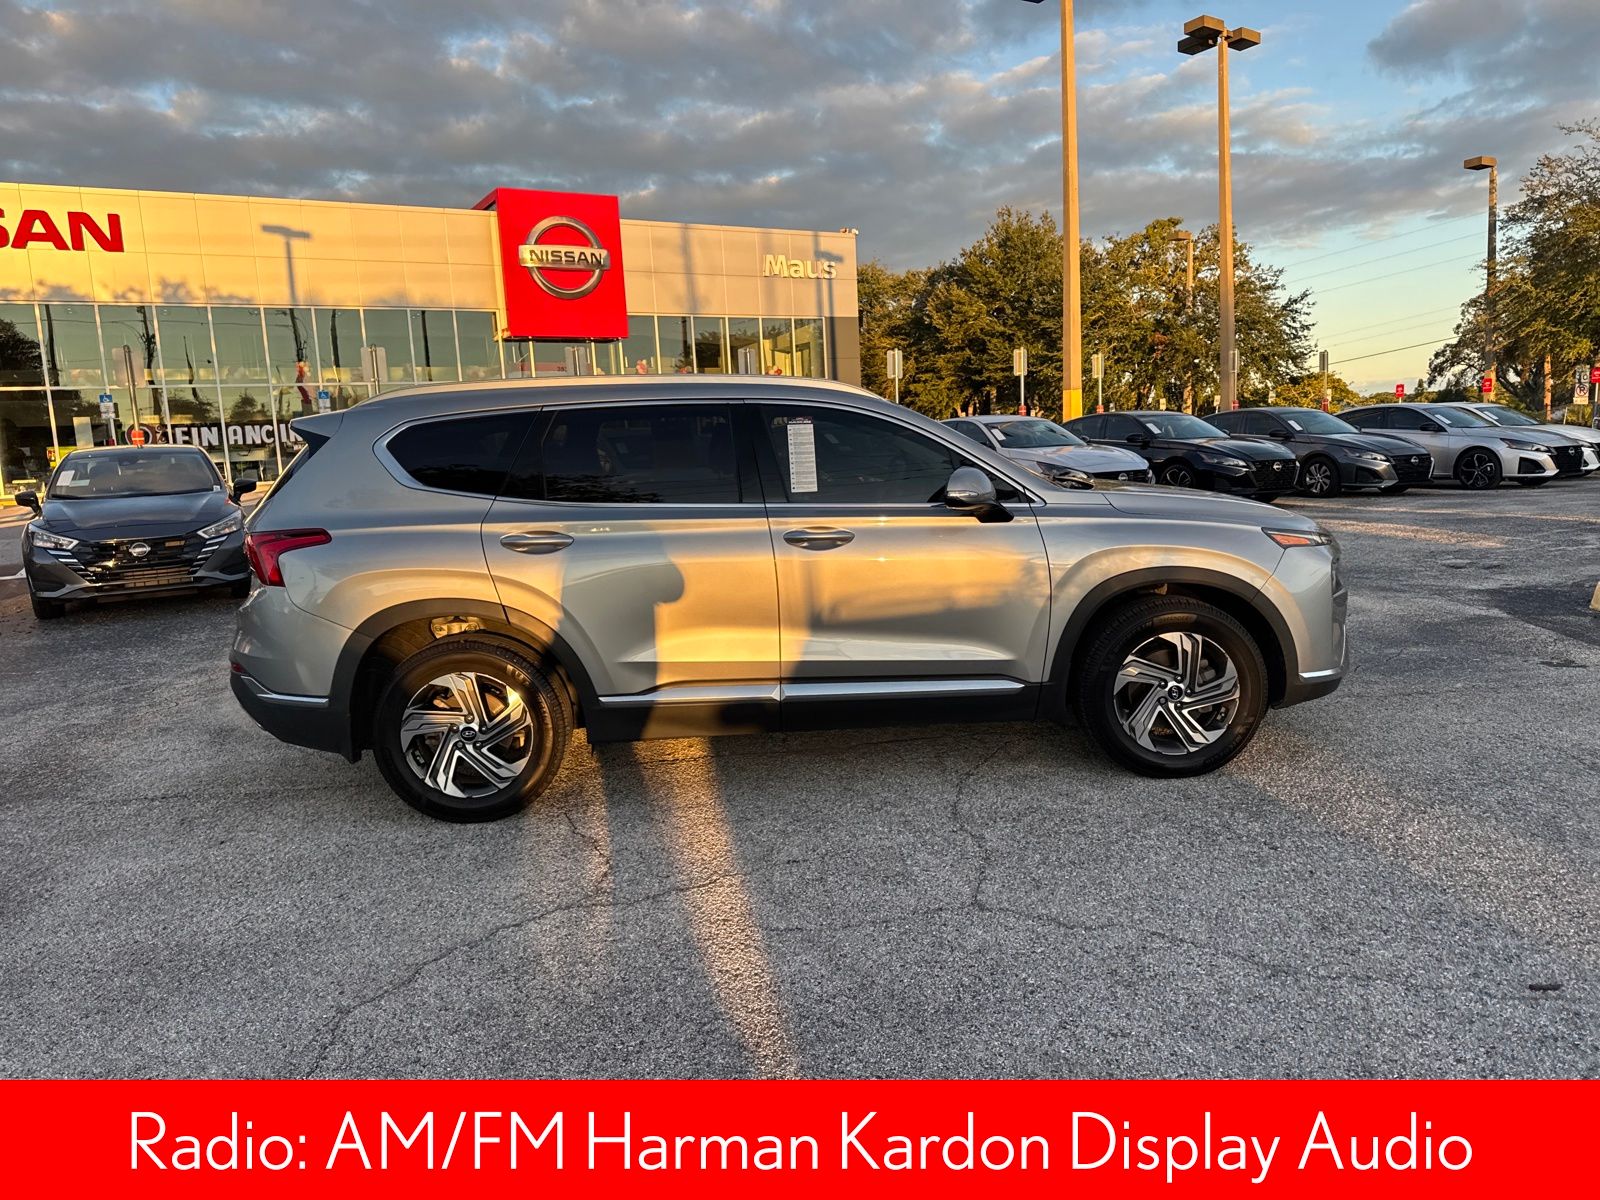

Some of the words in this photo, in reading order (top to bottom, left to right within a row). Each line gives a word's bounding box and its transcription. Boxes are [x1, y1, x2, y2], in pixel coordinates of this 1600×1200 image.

[0, 207, 125, 253] AN
[528, 249, 603, 266] NISSAN
[763, 254, 837, 279] Maus
